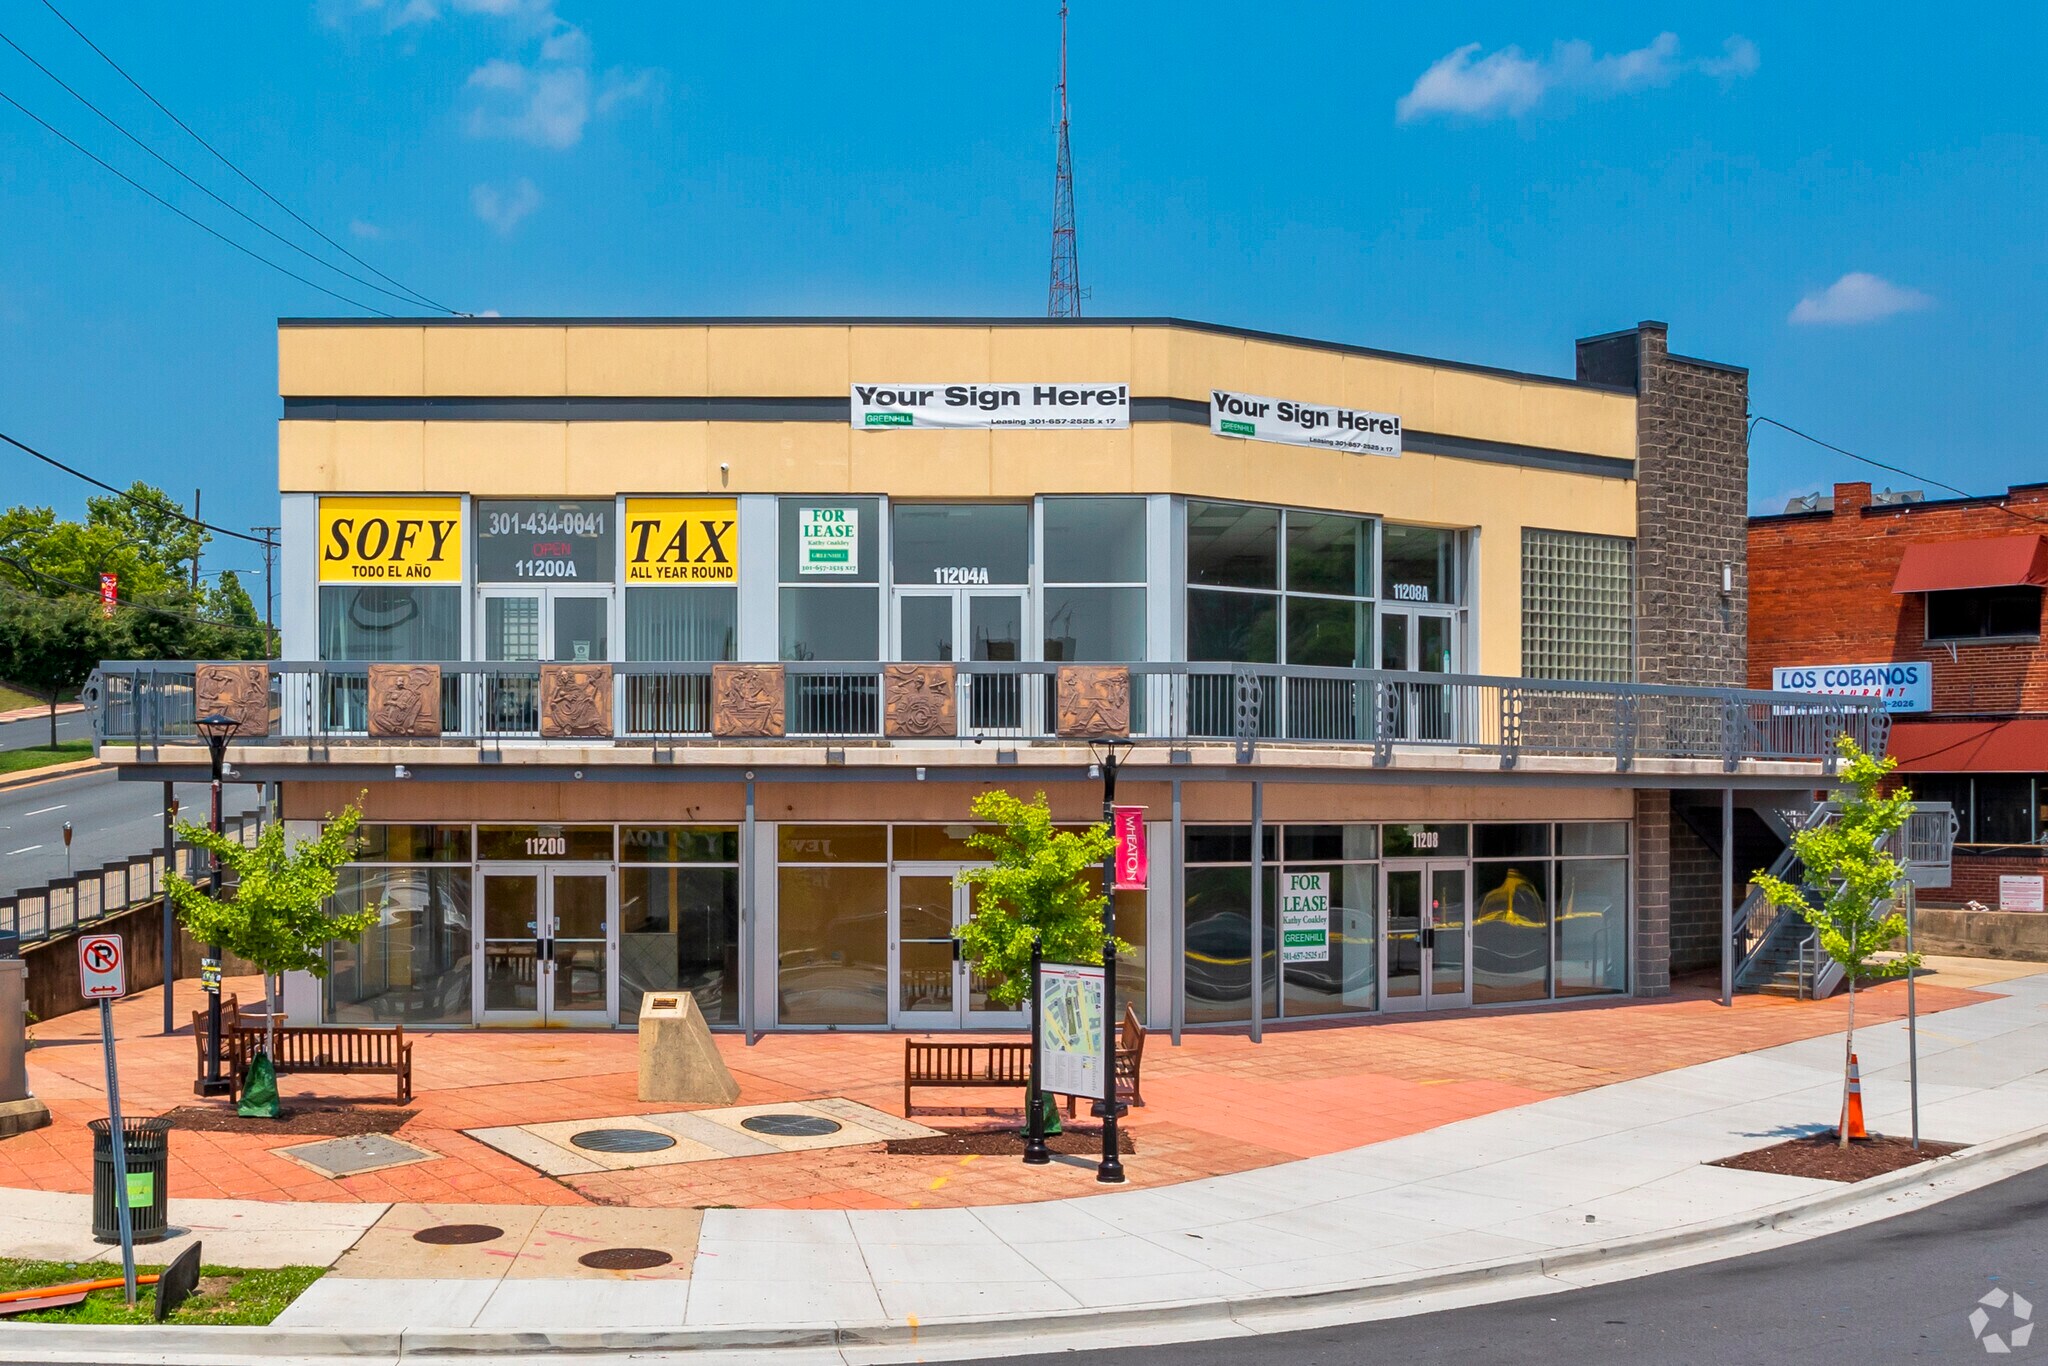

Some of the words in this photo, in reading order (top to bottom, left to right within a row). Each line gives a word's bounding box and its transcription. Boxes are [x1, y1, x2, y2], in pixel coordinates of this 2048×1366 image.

[855, 386, 935, 407] Your
[944, 386, 1021, 411] Sign
[1033, 386, 1127, 407] Here!
[866, 414, 912, 423] GREENHILL
[1213, 392, 1270, 418] Your
[1277, 402, 1329, 430] Sign
[1337, 410, 1400, 436] Here!
[1221, 421, 1254, 434] GREENHILL
[1309, 436, 1334, 446] Leasing
[489, 512, 604, 535] 301-434-0041
[812, 509, 846, 522] FOR
[803, 524, 855, 538] LEASE
[324, 518, 458, 562] SOFY
[630, 519, 735, 563] TAX
[532, 542, 572, 557] OPEN
[351, 565, 385, 578] TODO
[388, 565, 402, 578] EL
[406, 563, 432, 578] AÑO
[515, 560, 578, 577] 11200A
[630, 566, 652, 579] ALL
[656, 566, 688, 579] YEAR
[691, 566, 733, 579] ROUND
[933, 567, 989, 584] 11204A
[1393, 583, 1429, 602] 11208A
[1781, 671, 1816, 689] LOS
[1824, 666, 1918, 688] COBANOS
[1796, 687, 1906, 698] AURANT
[525, 837, 566, 856] 11200
[1125, 816, 1139, 881] WHEATON
[1412, 832, 1439, 848] 11208
[1290, 874, 1321, 891] FOR
[1283, 895, 1328, 912] LEASE
[1283, 915, 1302, 926] Kathy
[1303, 914, 1327, 925] Coakley
[1284, 932, 1325, 943] GREENHILL
